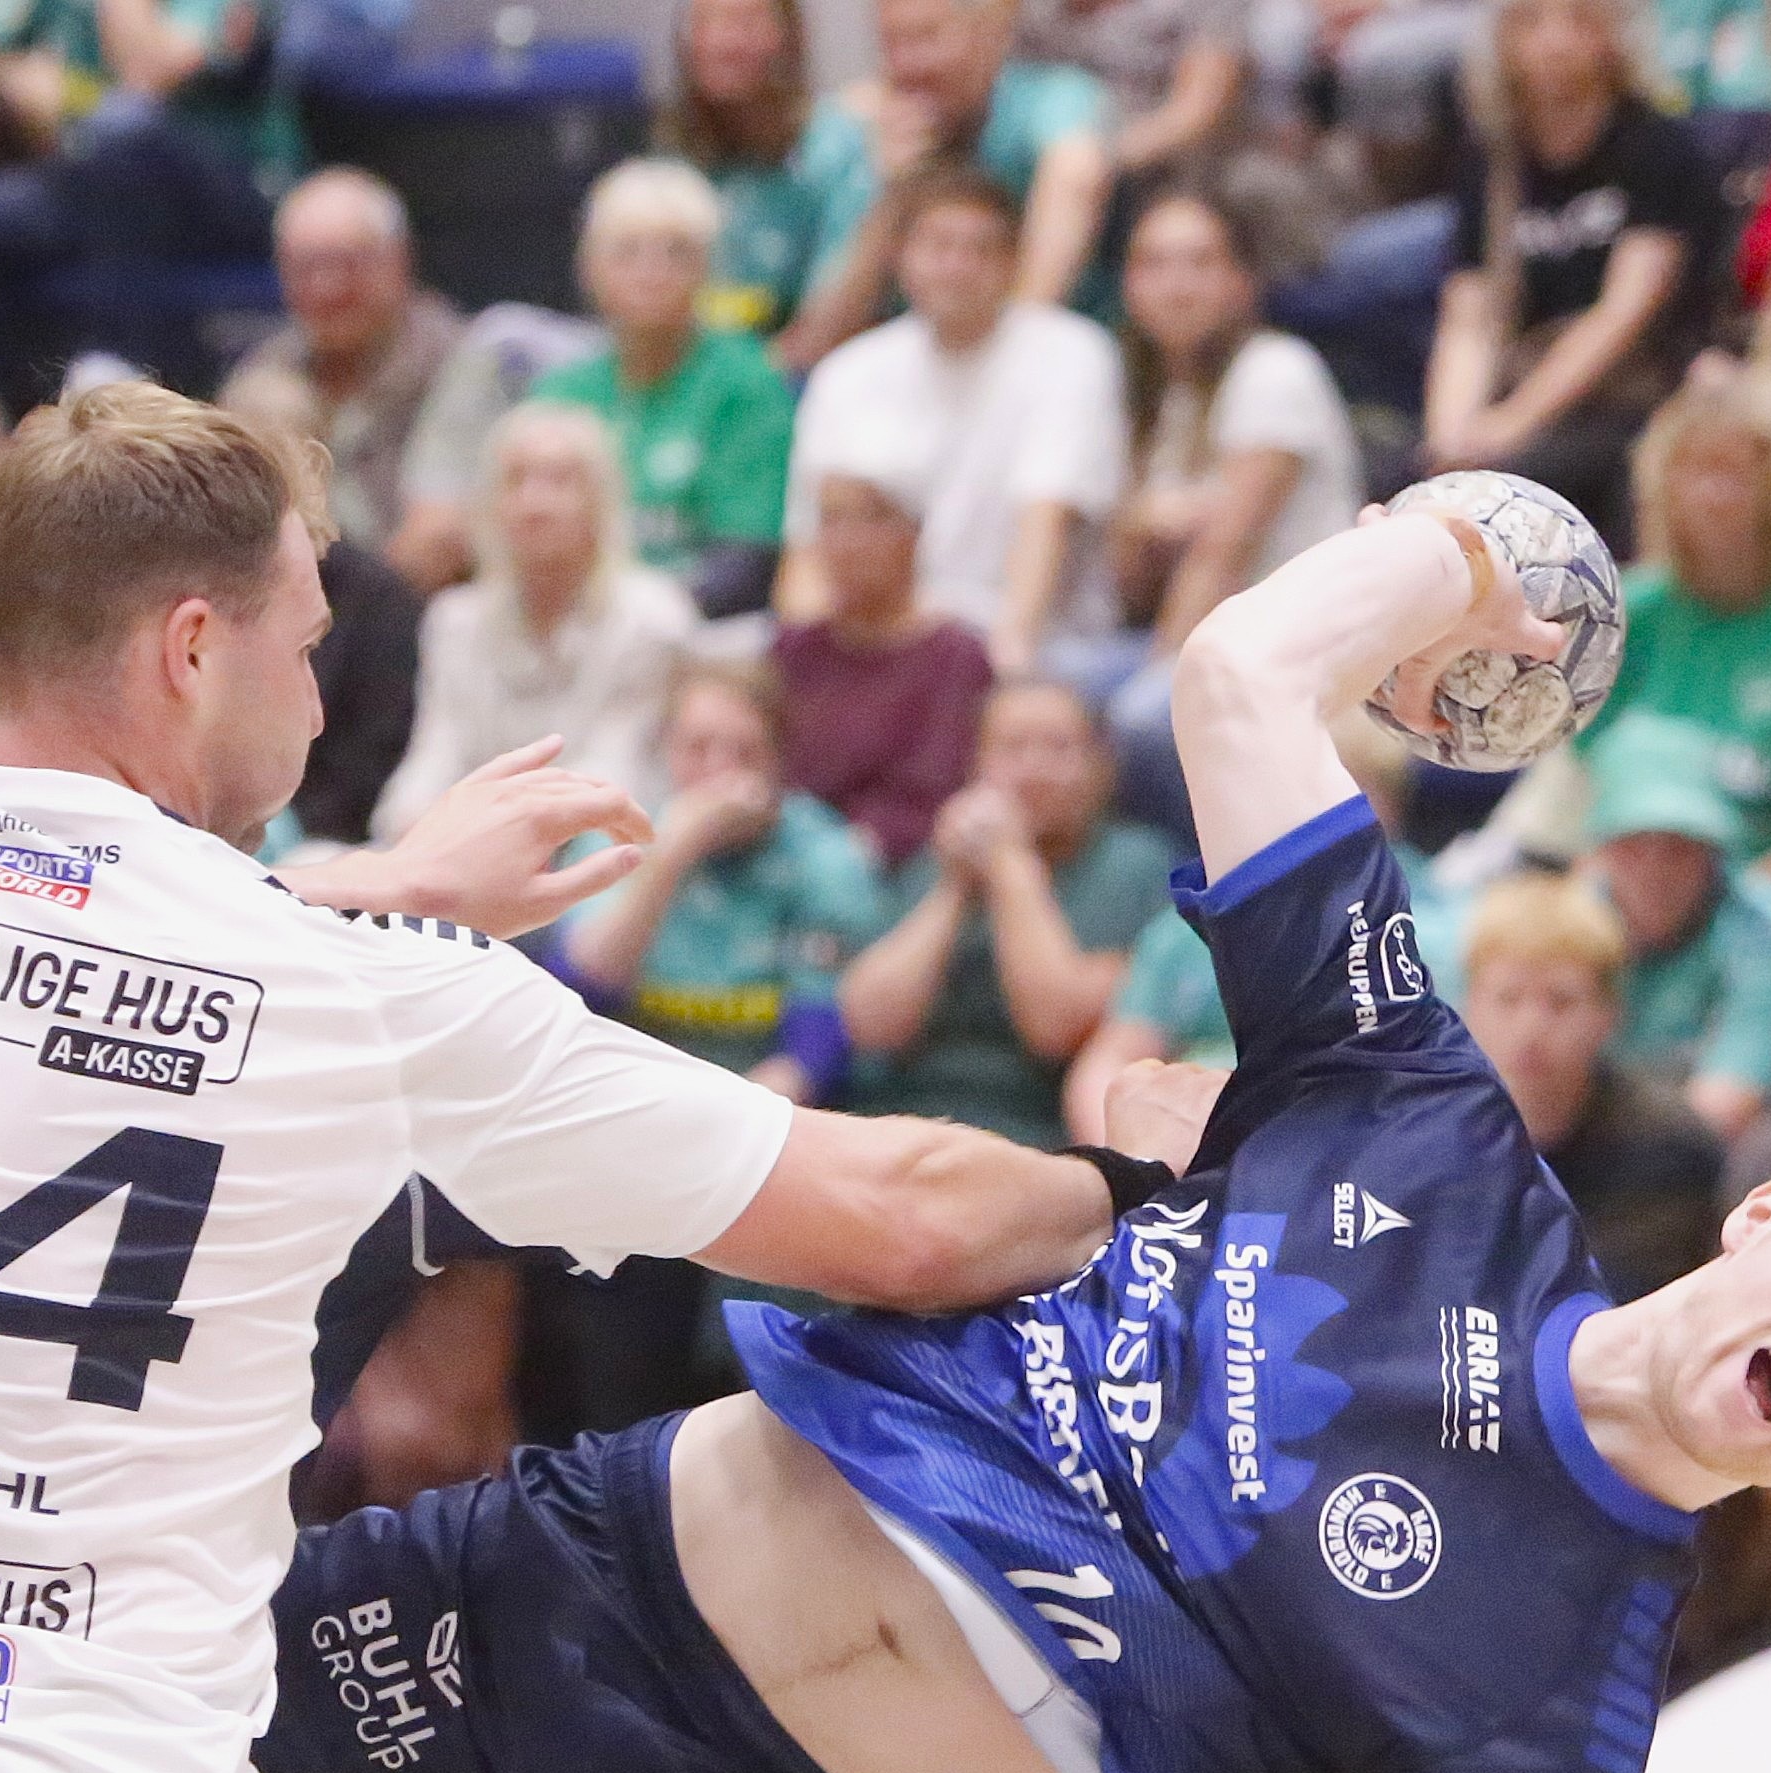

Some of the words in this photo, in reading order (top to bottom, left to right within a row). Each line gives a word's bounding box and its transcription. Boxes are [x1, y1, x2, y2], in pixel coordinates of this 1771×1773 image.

[102, 969, 235, 1045] HUS
[47, 1041, 198, 1088] A-KASSE
[1333, 1181, 1356, 1250] SELECT
[1213, 1243, 1268, 1503] Sparinvest
[1003, 1563, 1122, 1663] 10
[310, 1615, 405, 1770] GROUP
[347, 1598, 437, 1763] BUHL
